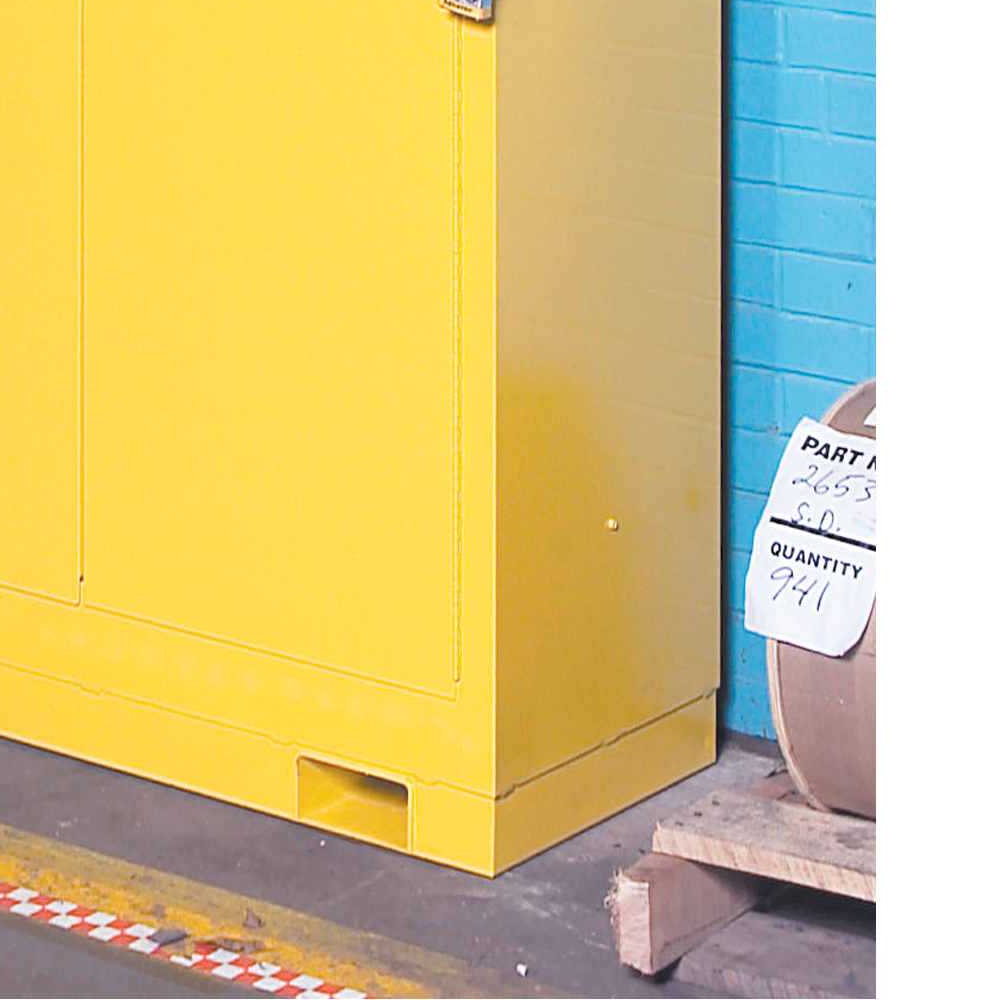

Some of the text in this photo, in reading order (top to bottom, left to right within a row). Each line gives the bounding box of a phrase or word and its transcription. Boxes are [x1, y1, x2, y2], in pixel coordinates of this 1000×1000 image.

[800, 435, 865, 466] PART
[770, 541, 864, 580] QUANTITY
[770, 566, 831, 612] 941
